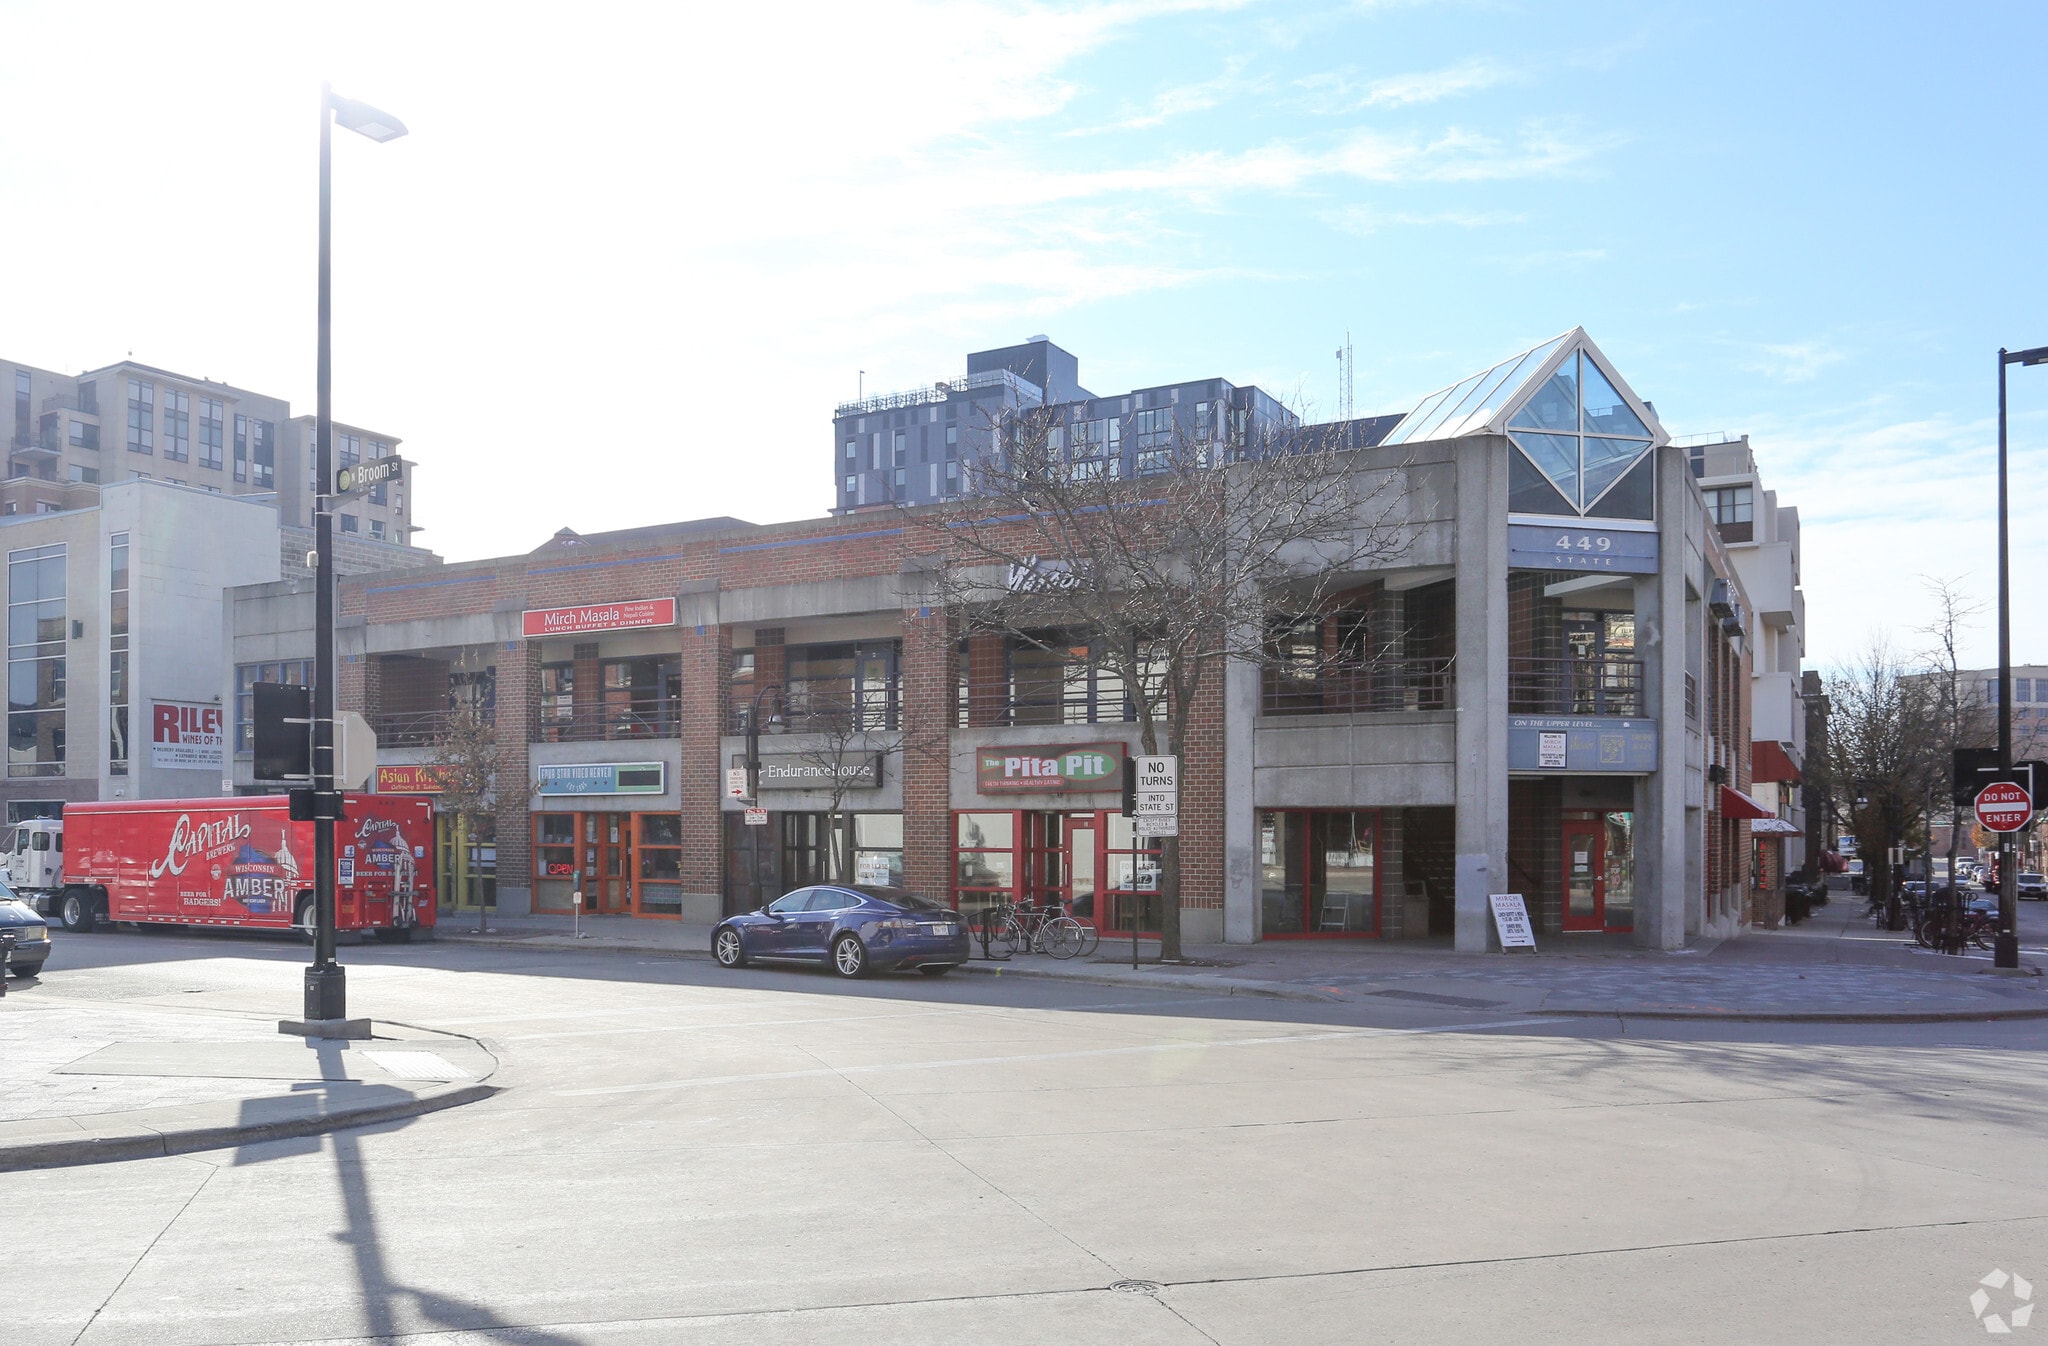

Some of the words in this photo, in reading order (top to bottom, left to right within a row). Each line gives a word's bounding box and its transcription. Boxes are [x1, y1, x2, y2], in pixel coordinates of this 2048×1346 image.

[351, 472, 356, 482] N
[358, 463, 389, 484] Broom
[391, 461, 398, 471] St
[1556, 535, 1611, 551] 449
[1555, 556, 1611, 565] STATE
[544, 613, 576, 626] Mirch
[580, 608, 619, 623] Masala
[619, 618, 653, 626] DINNER
[182, 734, 202, 744] WINES
[204, 735, 214, 745] OF
[1004, 757, 1058, 777] Pita
[1066, 754, 1104, 776] Pit
[1148, 762, 1164, 773] NO
[380, 767, 410, 783] Asian
[541, 768, 556, 780] FOUR
[556, 767, 571, 779] STAR
[571, 767, 589, 778] VIDEO
[589, 766, 612, 778] HEAVEN
[1140, 776, 1173, 786] TURNS
[1984, 793, 1998, 801] DO
[2001, 792, 2021, 800] NOT
[1140, 803, 1162, 811] STATE
[1165, 803, 1174, 811] ST
[1986, 814, 2021, 822] ENTER
[354, 818, 397, 838] CAPITAL
[151, 813, 251, 879] CAPITAL
[365, 854, 401, 864] AMBER
[235, 863, 275, 873] WISCONSIN
[548, 863, 574, 875] OPEN
[1610, 867, 1620, 875] TOP
[223, 878, 285, 900] AMBER
[183, 898, 221, 907] BADGERS!
